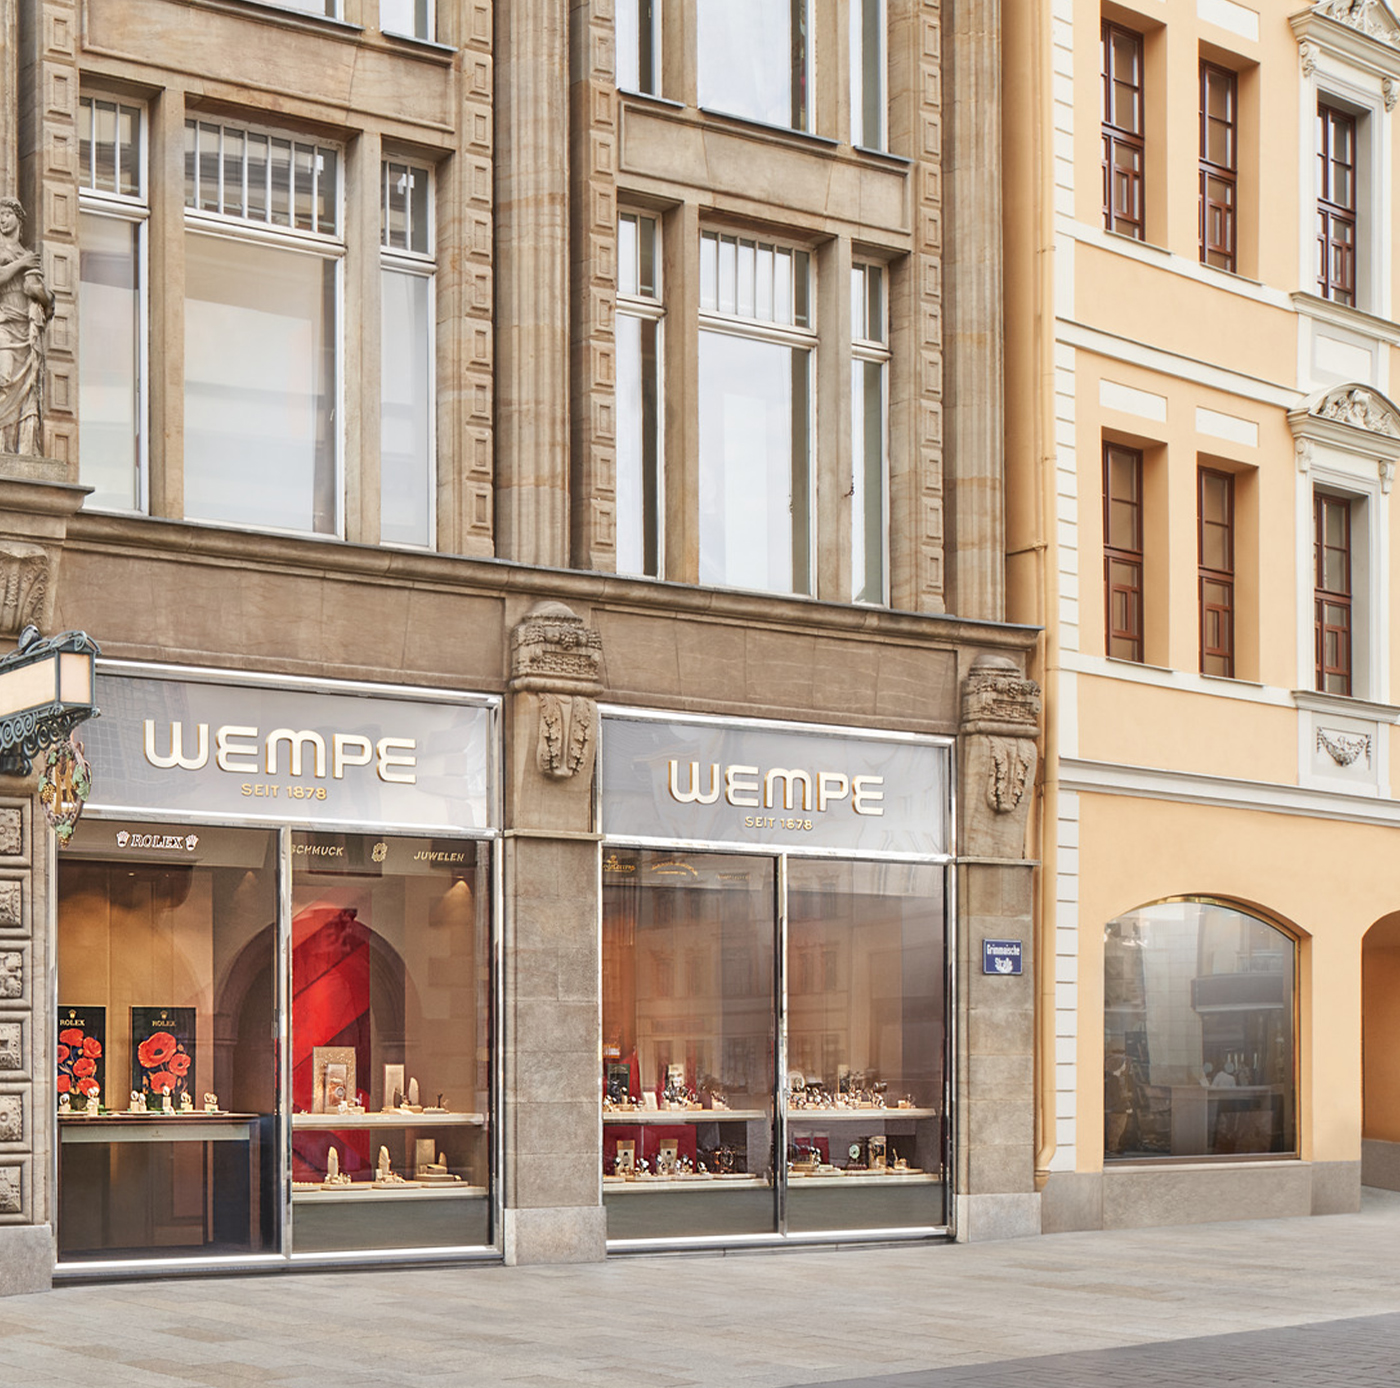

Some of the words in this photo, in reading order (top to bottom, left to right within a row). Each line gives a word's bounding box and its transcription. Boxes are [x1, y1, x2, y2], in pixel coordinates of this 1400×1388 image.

[143, 719, 417, 784] WEMPE
[241, 783, 280, 799] SEIT
[287, 785, 327, 801] 1878
[668, 759, 884, 816] WEMPE
[745, 816, 776, 829] SEIT
[780, 818, 813, 831] 1878
[130, 833, 184, 849] ROLEX
[291, 844, 344, 856] SCHMUCK
[414, 851, 465, 862] JUWELEN
